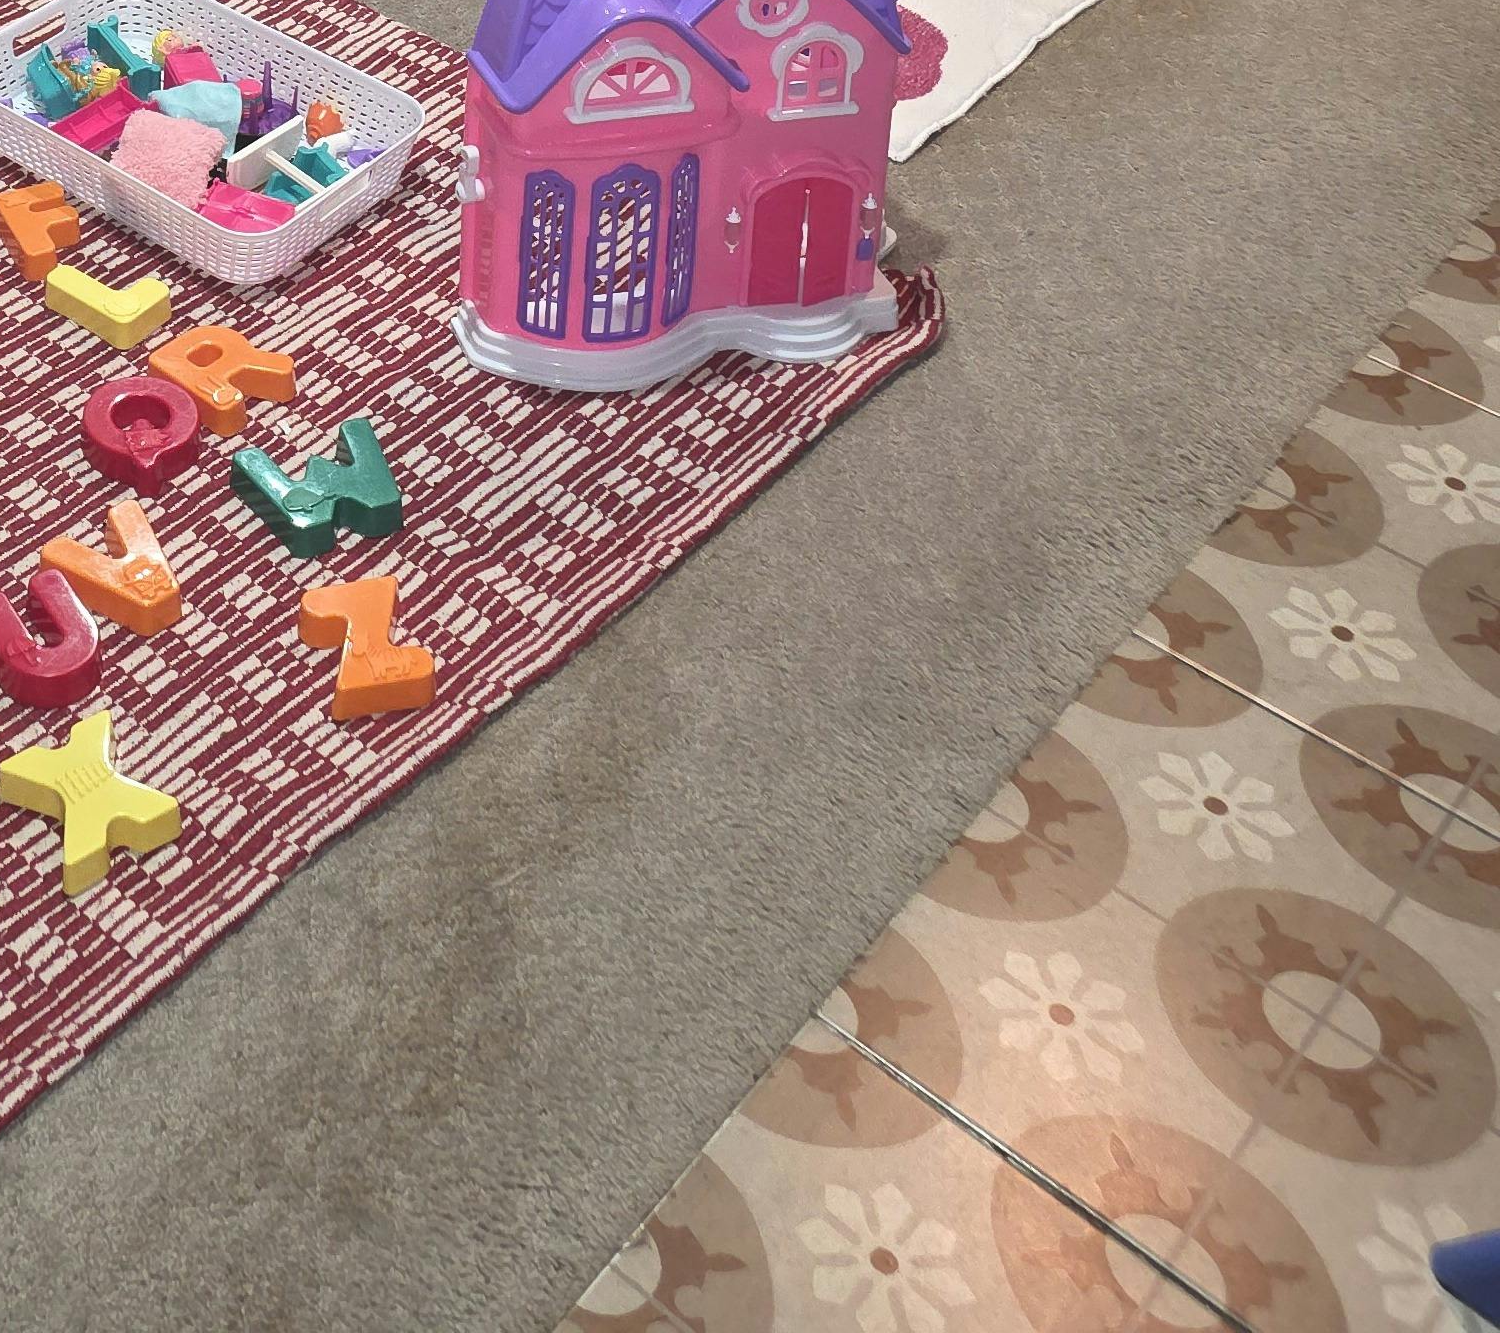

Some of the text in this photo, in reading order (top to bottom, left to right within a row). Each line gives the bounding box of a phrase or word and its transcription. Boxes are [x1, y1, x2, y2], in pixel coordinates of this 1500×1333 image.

[45, 264, 172, 351] L
[83, 376, 201, 497] Q
[148, 324, 297, 437] R
[230, 417, 404, 559] W
[40, 499, 183, 636] V
[300, 575, 437, 722] Z
[0, 709, 183, 897] X
